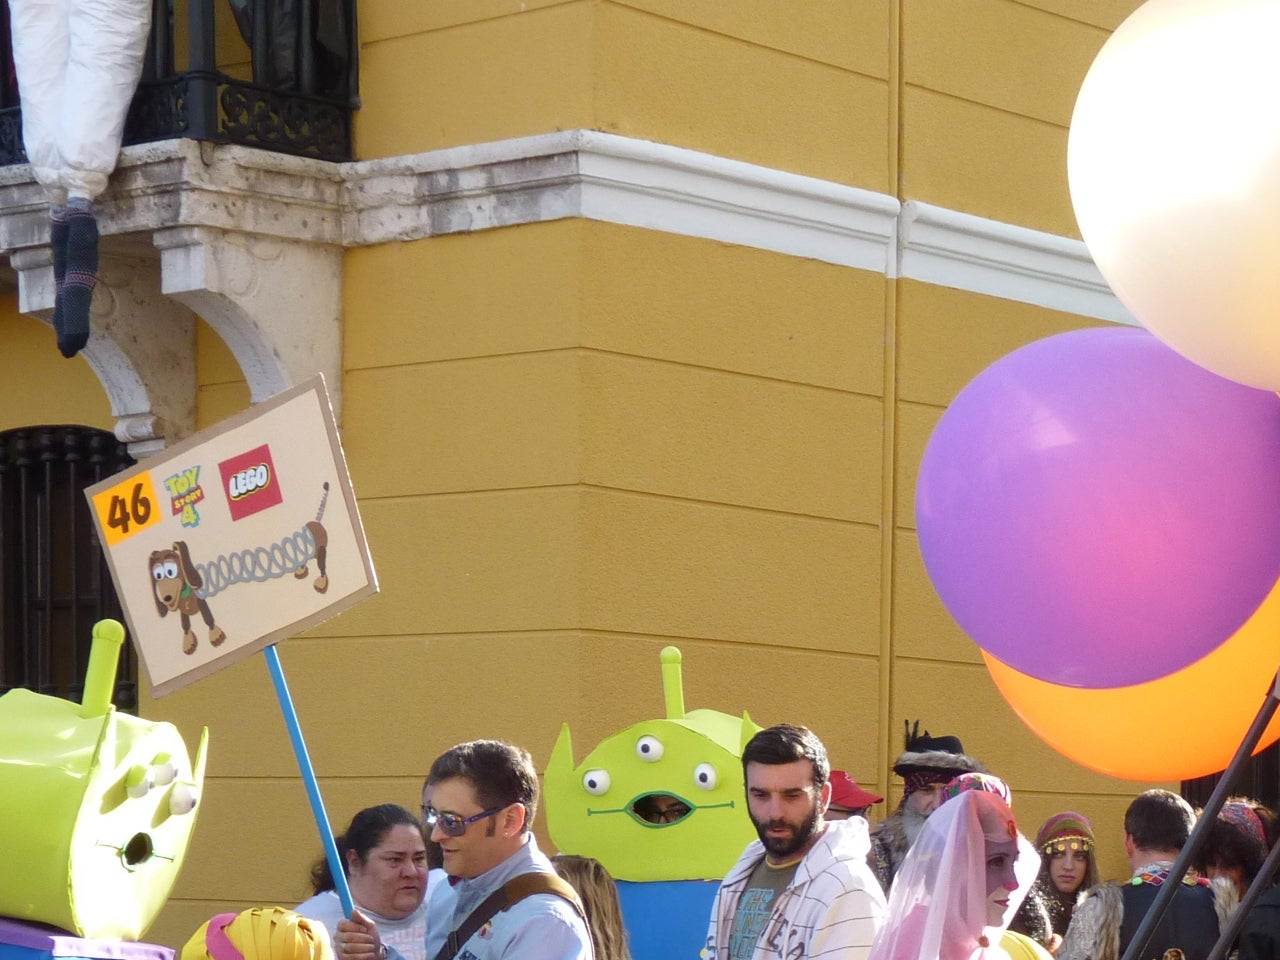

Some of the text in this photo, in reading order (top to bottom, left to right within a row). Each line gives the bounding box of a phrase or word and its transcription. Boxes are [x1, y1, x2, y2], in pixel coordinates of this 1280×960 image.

[165, 467, 199, 495] TOY
[229, 465, 268, 497] LEGO
[107, 483, 151, 534] 46
[173, 488, 202, 509] STORY
[181, 504, 197, 524] 4
